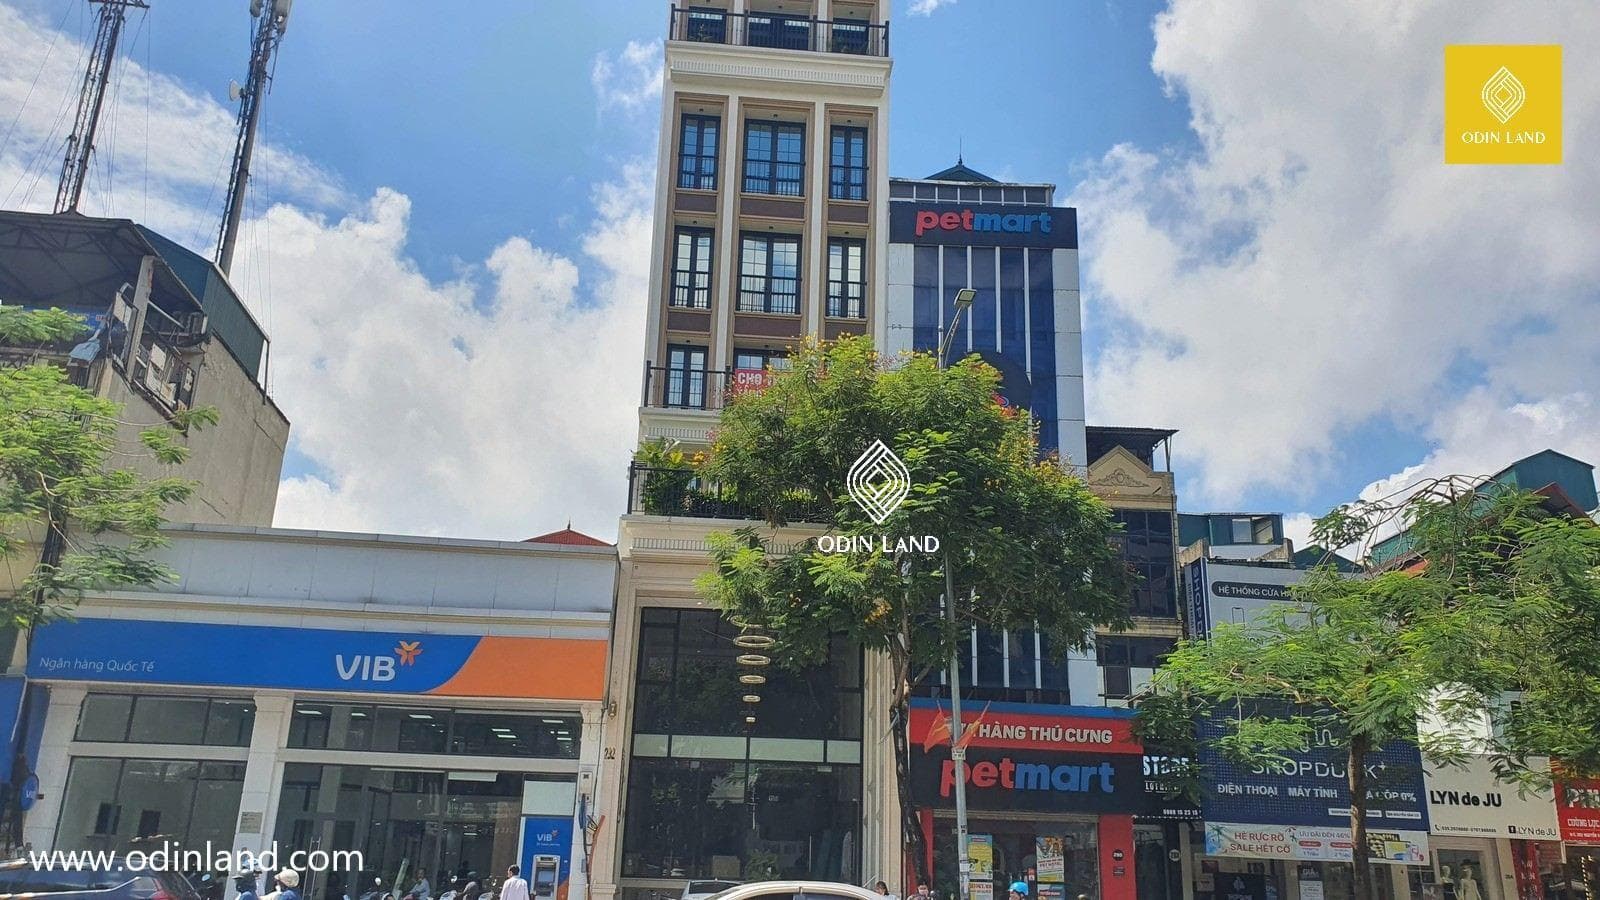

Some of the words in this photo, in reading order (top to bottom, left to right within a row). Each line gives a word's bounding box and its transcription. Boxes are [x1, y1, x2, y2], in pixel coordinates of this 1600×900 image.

[915, 208, 1052, 237] petmart
[1218, 585, 1230, 595] HỆ
[1231, 585, 1260, 596] THỐNG
[1261, 587, 1280, 597] CỬA
[39, 657, 71, 671] Ngân
[73, 657, 104, 673] hàng
[106, 658, 139, 673] Quốc
[335, 654, 396, 682] VIB
[978, 721, 1026, 739] HÀNG
[1029, 724, 1064, 742] THÚ
[1064, 728, 1113, 744] CƯNG
[940, 757, 1115, 797] petmart
[1217, 782, 1243, 797] ĐIỆN
[1245, 785, 1279, 798] THOẠI
[1288, 785, 1311, 798] MÁY
[1313, 785, 1338, 799] TÍNH
[1430, 790, 1459, 805] LYN
[1461, 791, 1480, 807] de
[1483, 793, 1502, 808] JU
[537, 833, 553, 842] VIB
[1234, 830, 1248, 841] HÈ
[1249, 831, 1270, 843] RỰC
[1518, 826, 1534, 836] LYN
[1535, 828, 1545, 836] de
[1546, 828, 1557, 837] JU
[1230, 843, 1254, 852] SALE
[1255, 842, 1274, 853] HẾT
